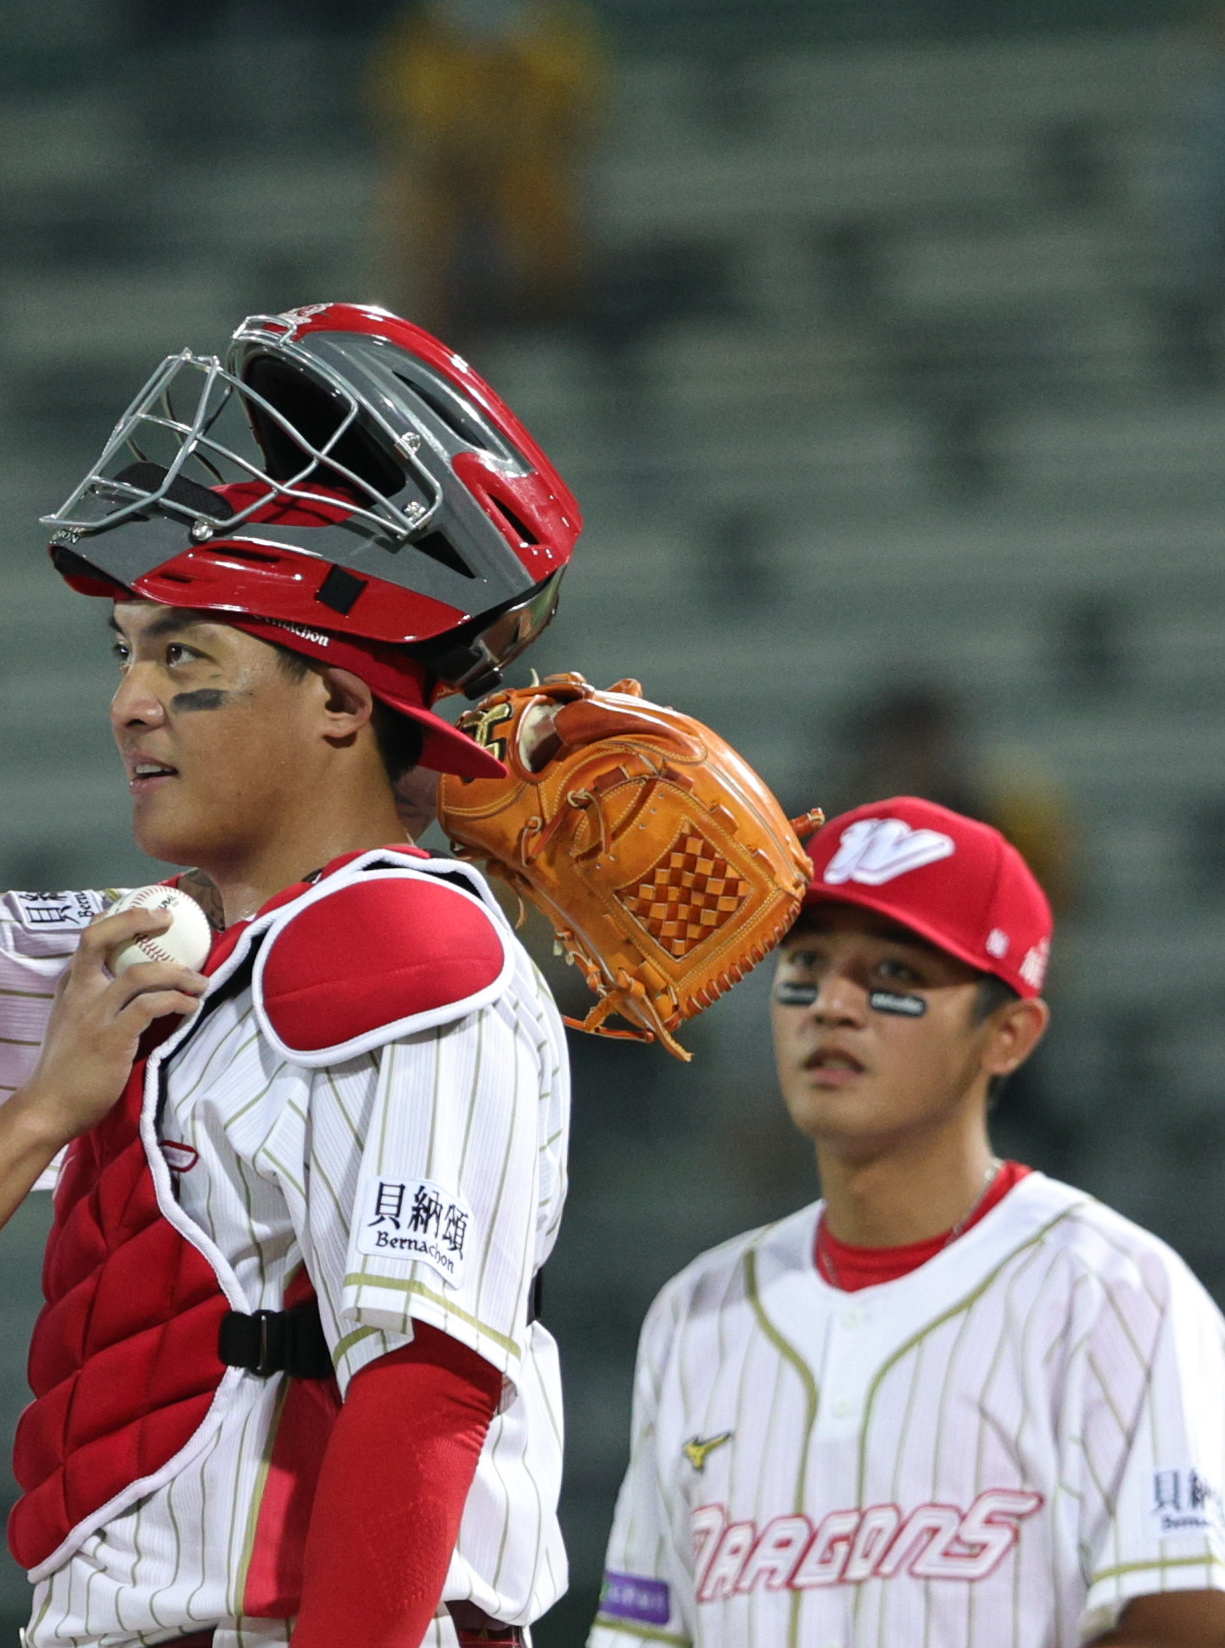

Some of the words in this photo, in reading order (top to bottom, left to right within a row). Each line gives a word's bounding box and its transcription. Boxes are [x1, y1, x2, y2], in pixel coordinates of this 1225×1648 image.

[367, 1181, 469, 1261] 貝納頌
[375, 1230, 454, 1274] Bernachon
